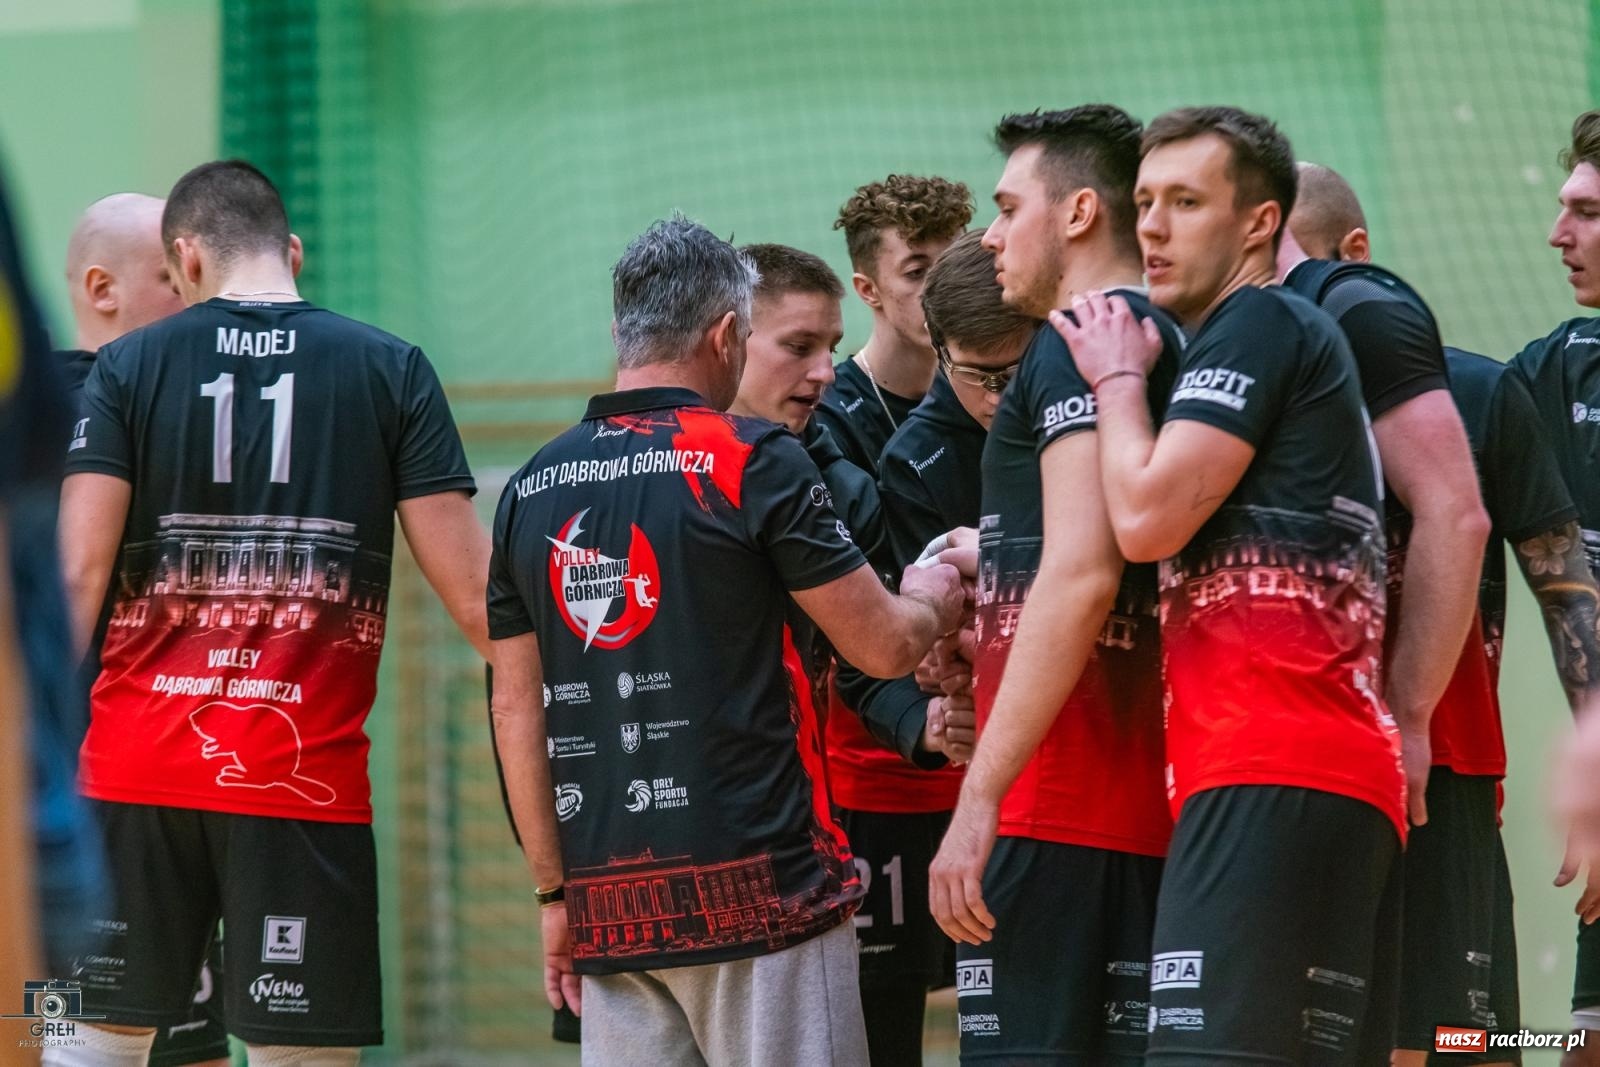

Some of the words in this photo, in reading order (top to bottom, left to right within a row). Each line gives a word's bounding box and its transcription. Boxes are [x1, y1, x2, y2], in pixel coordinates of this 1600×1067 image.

[216, 327, 296, 358] MADEJ
[1043, 393, 1097, 428] BIOF
[200, 372, 295, 484] 11
[514, 464, 559, 501] VOLLEY
[558, 455, 629, 487] DĄBROWA
[632, 446, 715, 475] GÓRNICZA
[553, 548, 600, 567] VOLLEY
[569, 559, 630, 585] DĄBROWA
[564, 579, 625, 603] GÓRNICZA
[207, 647, 262, 669] VOLLEY
[151, 674, 224, 698] DĄBROWA
[226, 676, 303, 704] GÓRNICZA
[635, 671, 671, 685] ŚLĄSKA
[653, 786, 688, 801] SPORTU
[655, 797, 690, 810] FUNDACJA
[257, 978, 305, 998] NEMO
